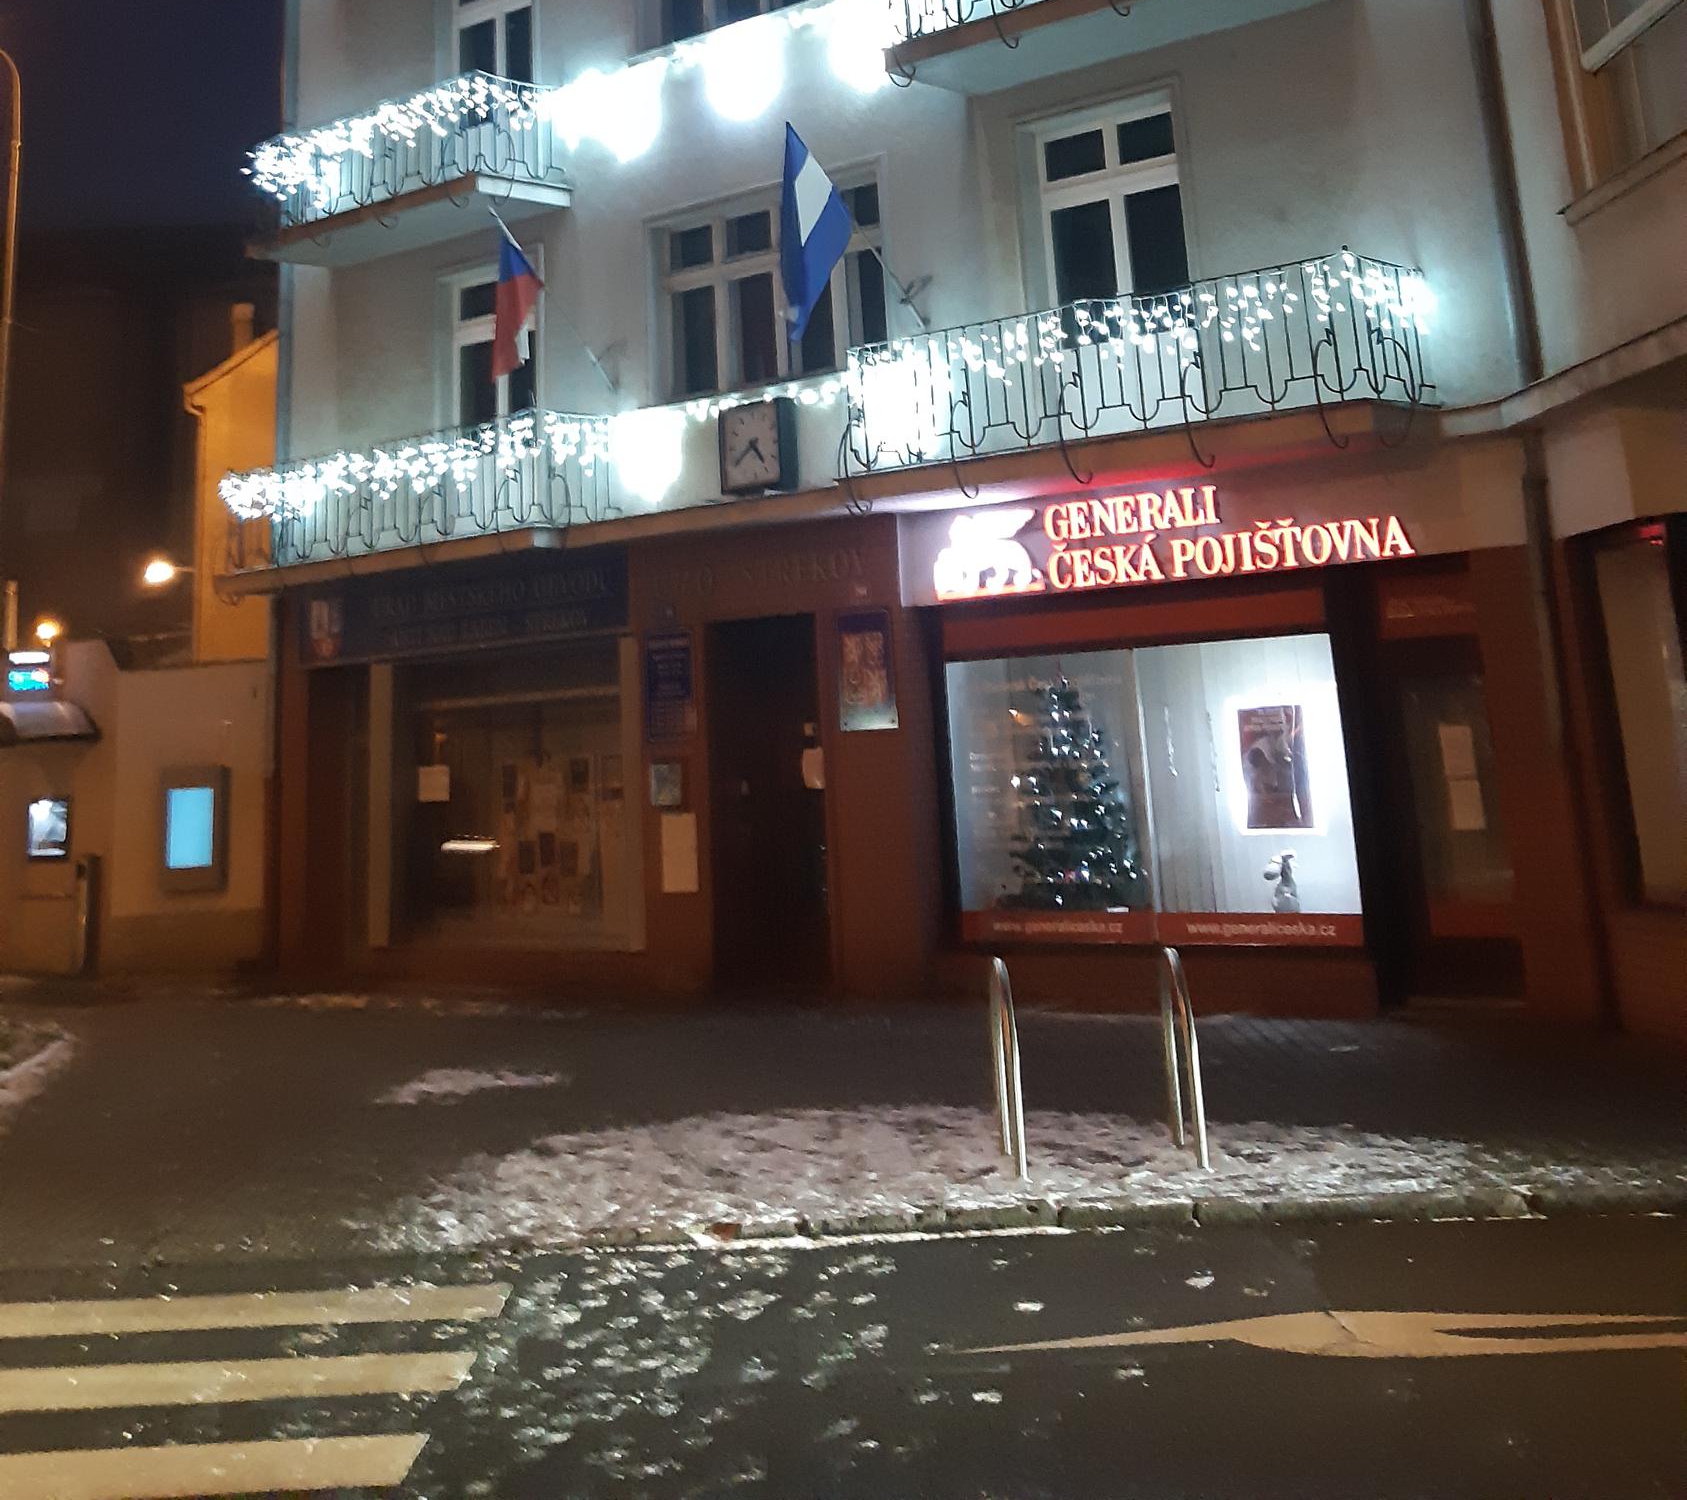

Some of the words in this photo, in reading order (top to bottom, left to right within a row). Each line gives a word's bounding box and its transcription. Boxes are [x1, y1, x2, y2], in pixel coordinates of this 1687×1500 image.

[1043, 485, 1221, 541] GENERALI
[1047, 533, 1166, 590] ČESKÁ
[1169, 516, 1416, 579] POJIŠŤOVNA
